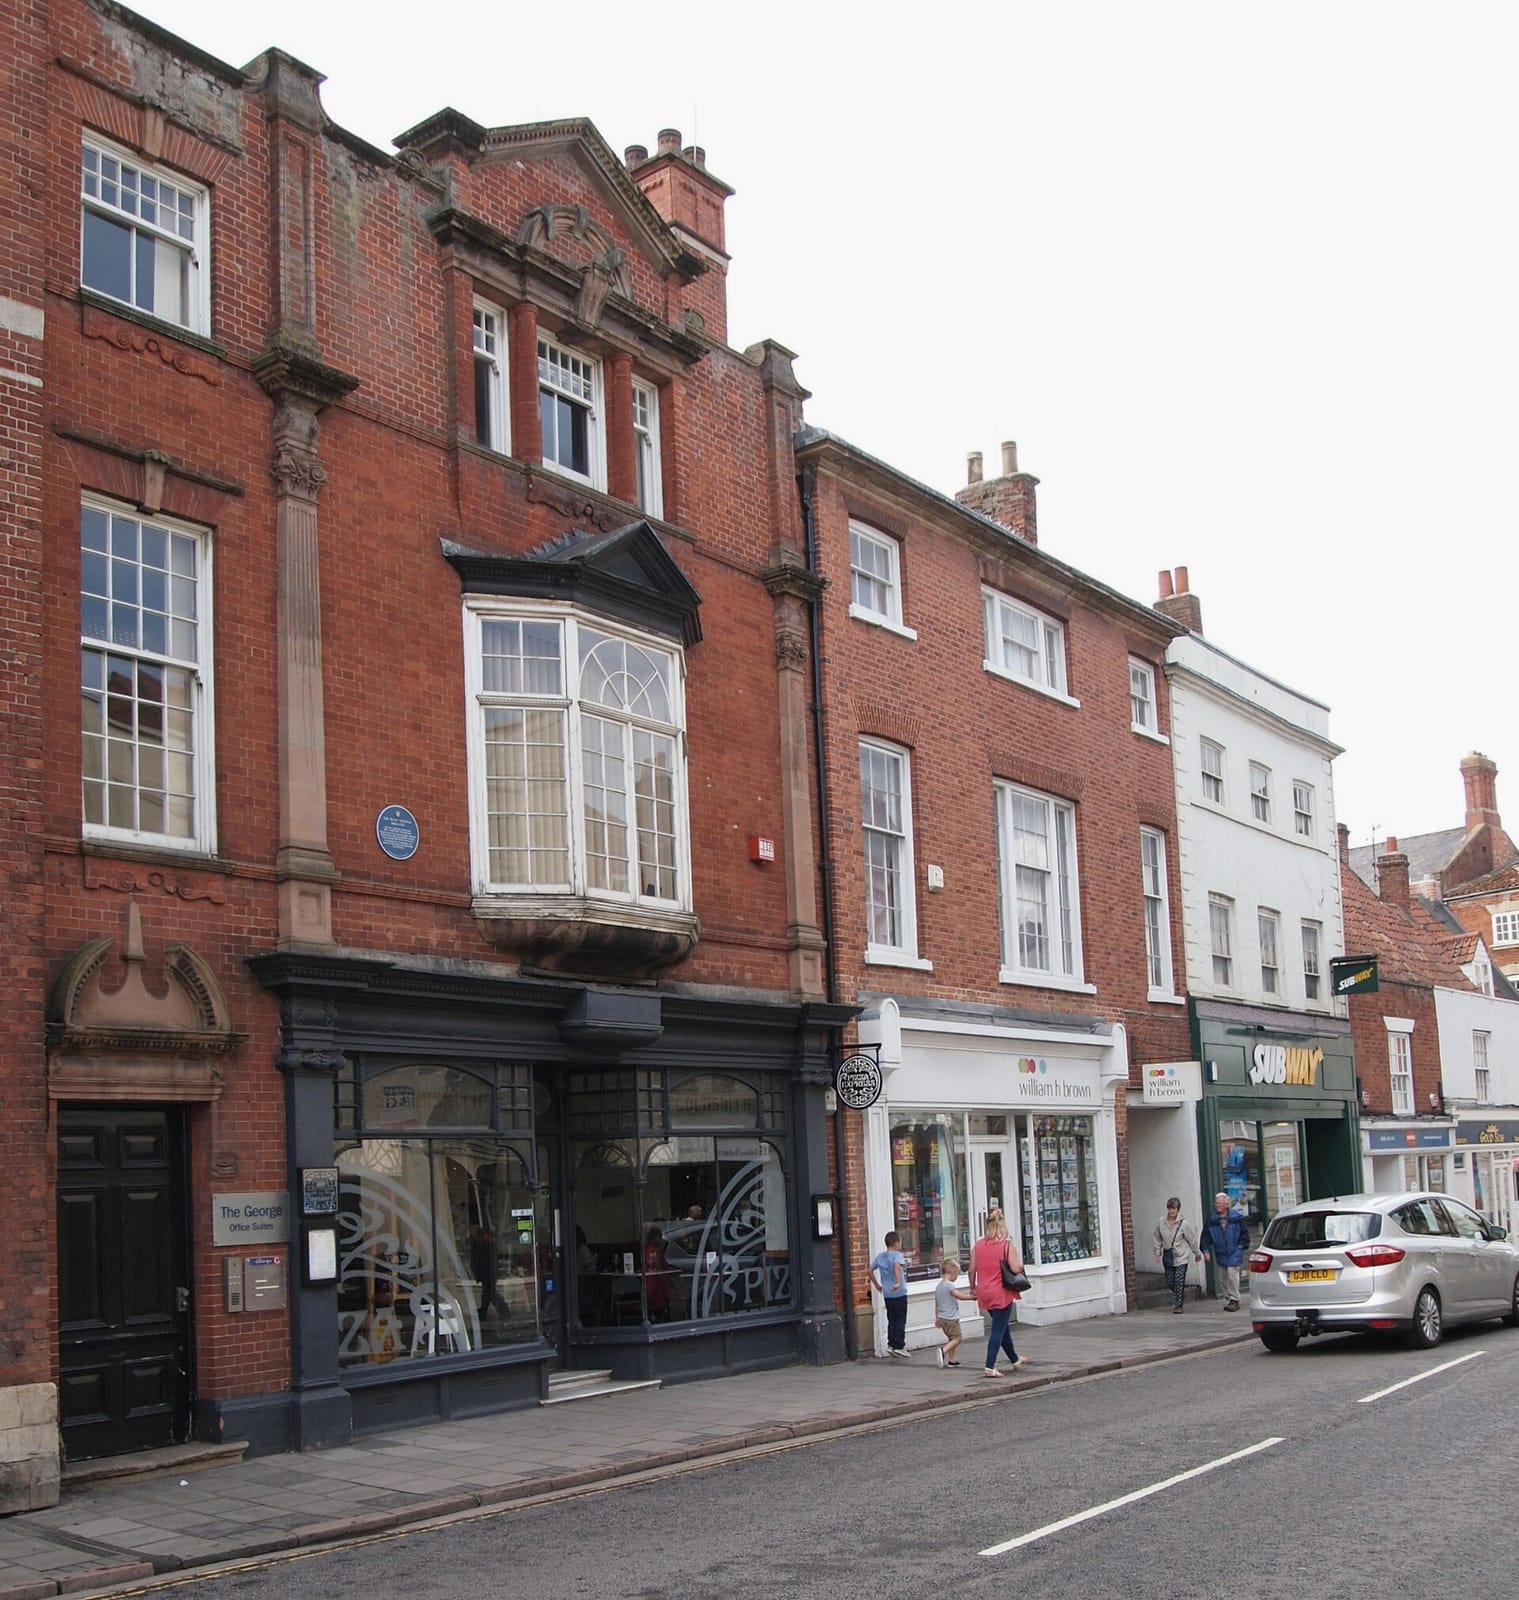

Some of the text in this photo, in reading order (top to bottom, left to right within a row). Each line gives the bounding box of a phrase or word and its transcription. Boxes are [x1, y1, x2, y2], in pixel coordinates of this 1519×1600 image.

[1338, 967, 1373, 990] SUBWAY
[1249, 1044, 1324, 1086] SUBWAY
[842, 1080, 875, 1088] EXPRESS
[1019, 1079, 1091, 1098] william h brown
[1149, 1078, 1180, 1087] william
[1149, 1088, 1185, 1097] h brown
[221, 1205, 282, 1219] The George
[229, 1222, 274, 1232] Office Suites
